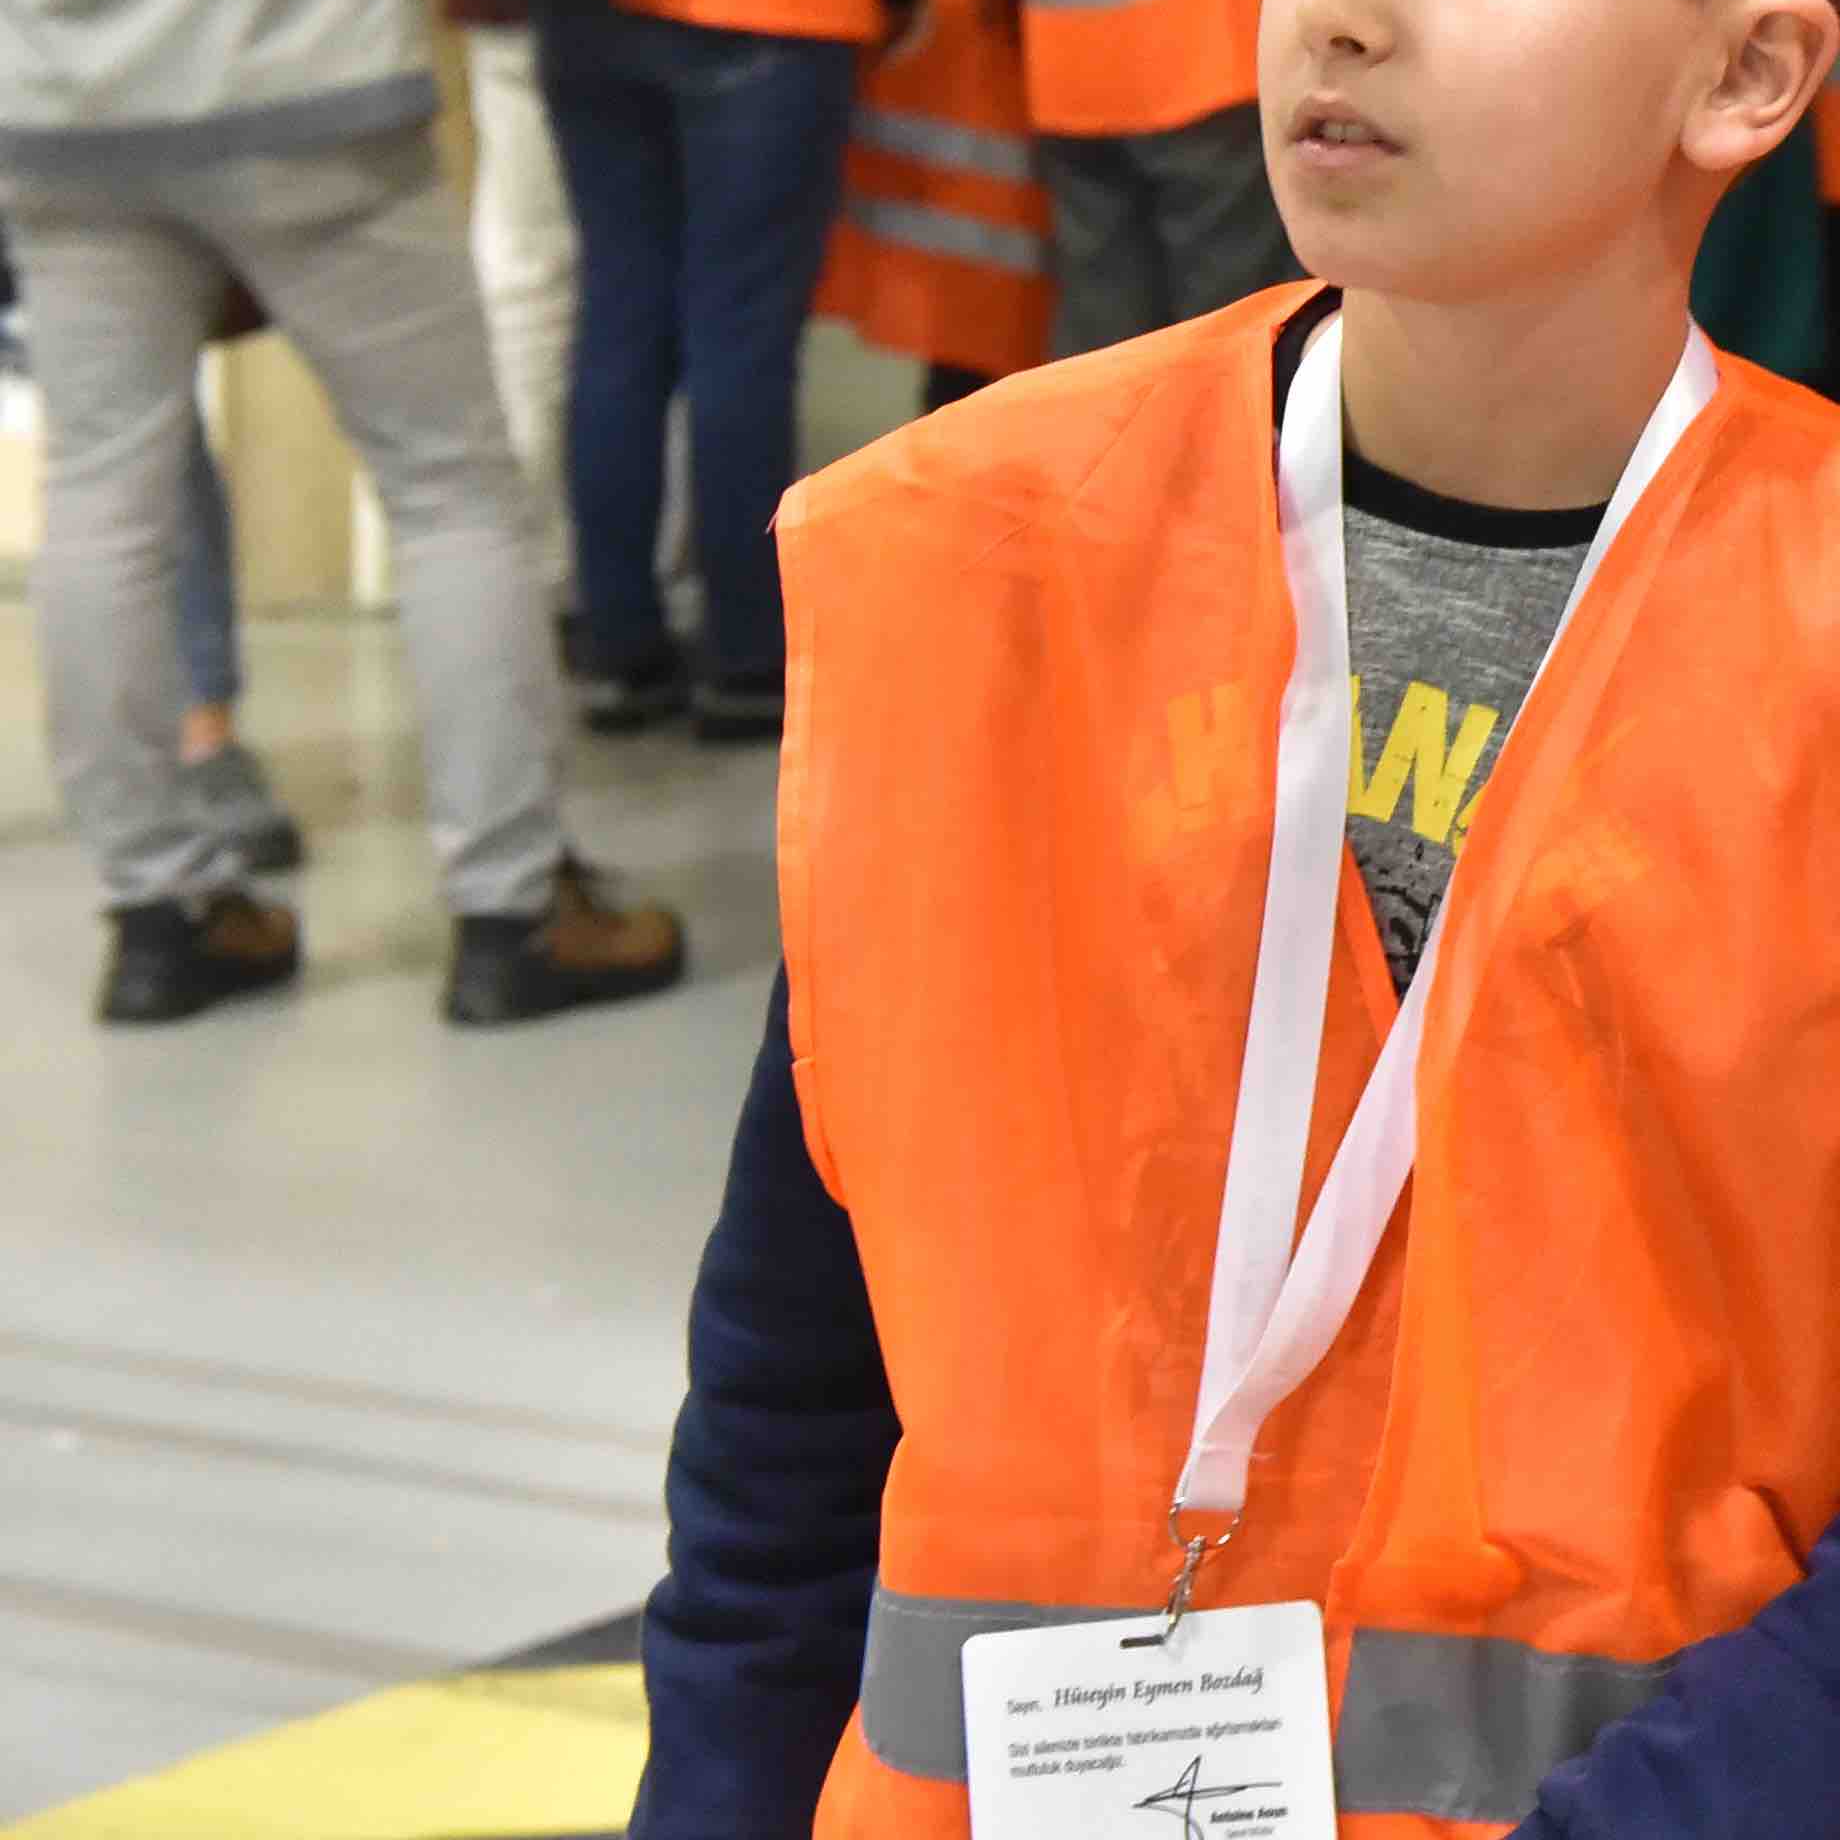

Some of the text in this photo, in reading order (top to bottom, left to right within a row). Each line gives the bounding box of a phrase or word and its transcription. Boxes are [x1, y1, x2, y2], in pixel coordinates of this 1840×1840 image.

[1053, 1681, 1127, 1711] Hüseyin
[1132, 1679, 1194, 1706] Eymen
[1199, 1664, 1264, 1695] Bozdağ
